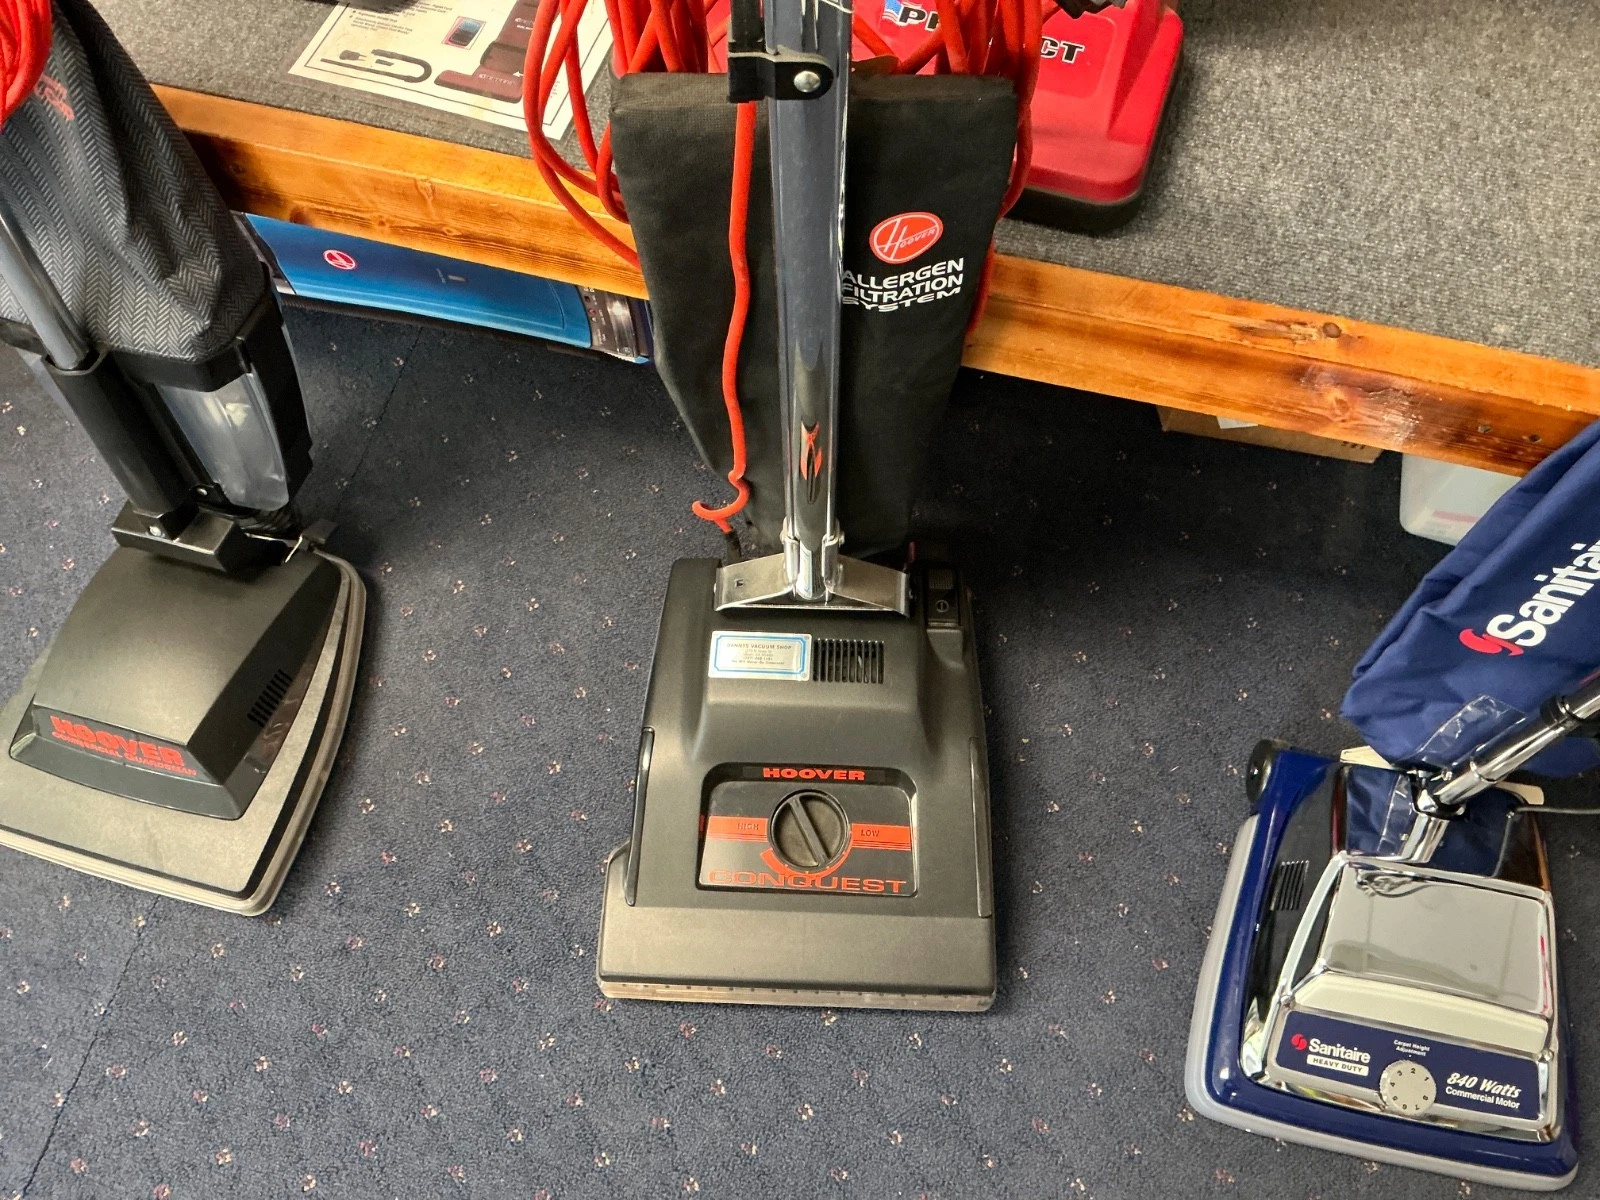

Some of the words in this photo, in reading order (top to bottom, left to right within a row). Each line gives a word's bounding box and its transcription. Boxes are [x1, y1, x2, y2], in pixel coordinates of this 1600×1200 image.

[842, 257, 964, 290] ALLERGEN
[841, 286, 962, 312] SYSTEM
[50, 715, 185, 766] HOOVER
[762, 767, 866, 781] HOOVER
[737, 822, 760, 831] HIGH
[860, 829, 881, 838] LOW
[709, 869, 907, 894] CONQUEST
[1308, 1039, 1371, 1065] Sanitaire
[1393, 1039, 1412, 1048] Carpet
[1412, 1043, 1430, 1052] Height
[1396, 1046, 1426, 1056] Adjustment
[1312, 1058, 1341, 1070] HEAVY
[1341, 1063, 1364, 1074] DUTY
[1446, 1072, 1478, 1088] 840
[1479, 1078, 1522, 1099] Watts
[1445, 1086, 1495, 1104] Commercial
[1495, 1096, 1521, 1109] Motor
